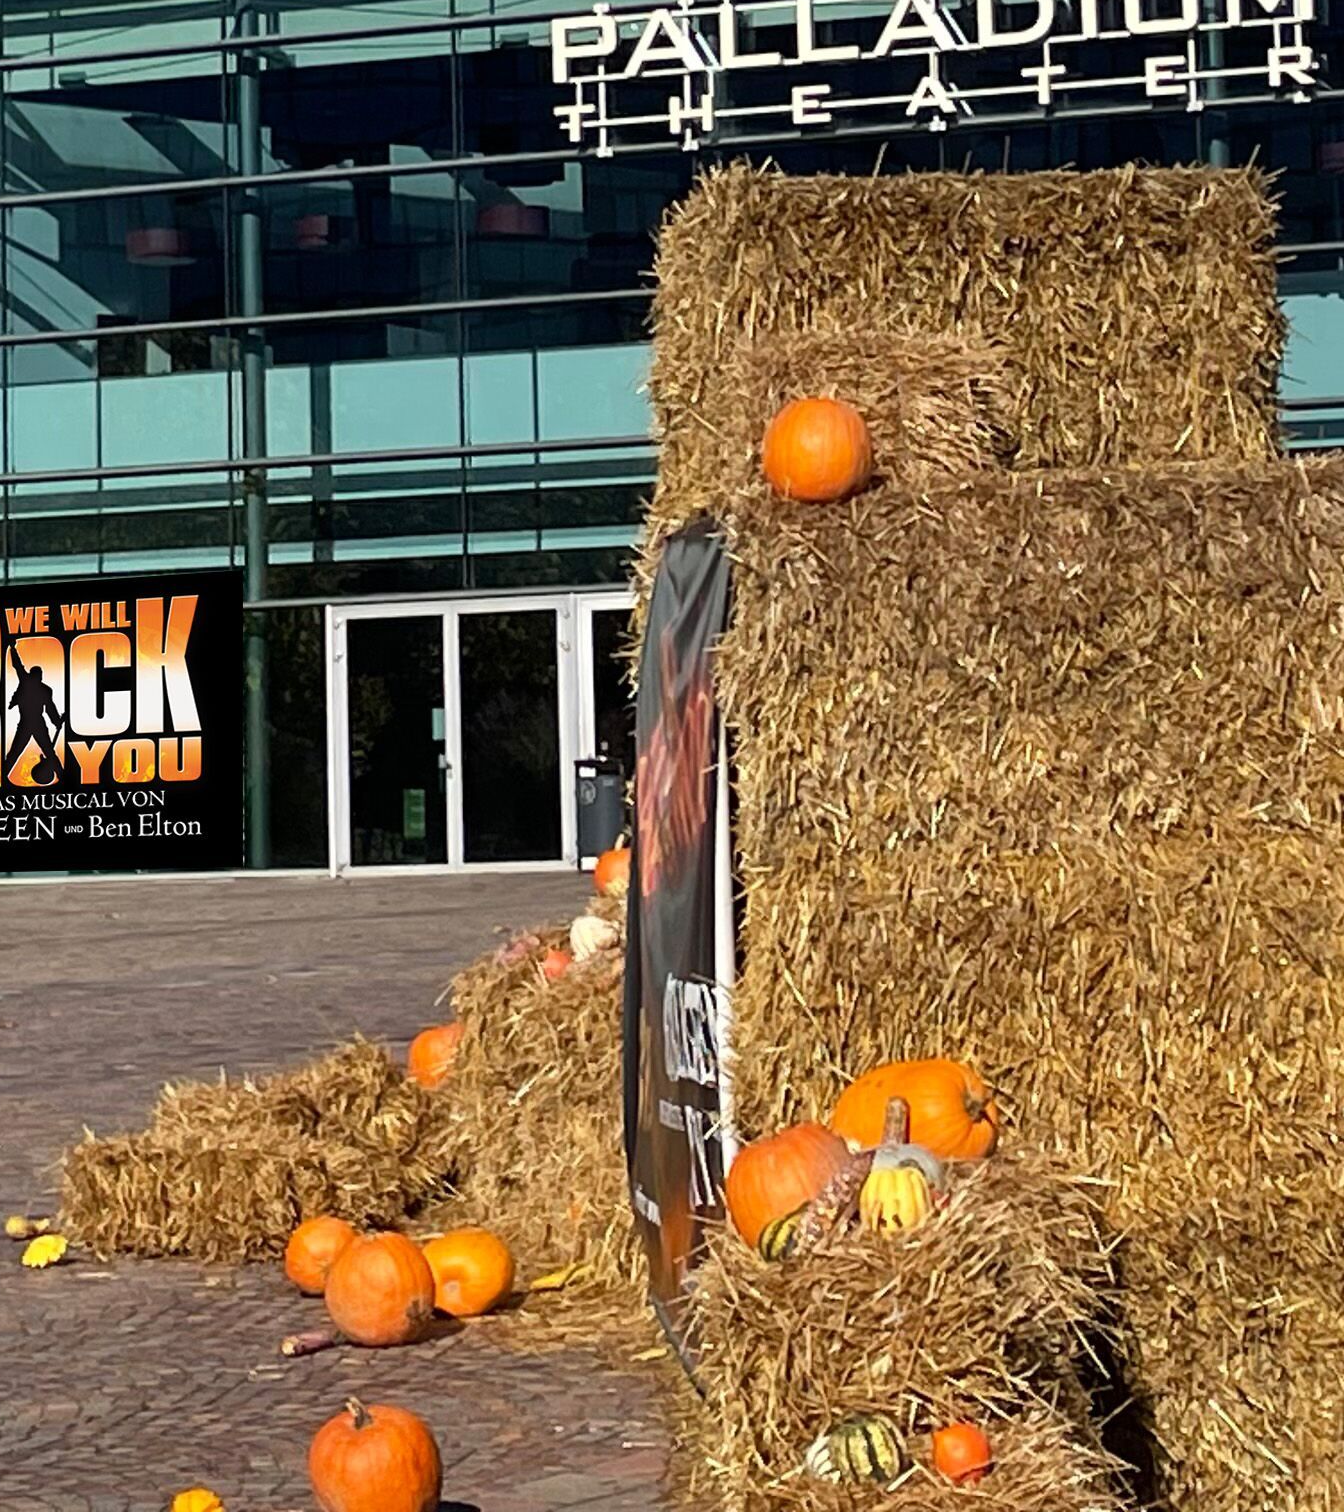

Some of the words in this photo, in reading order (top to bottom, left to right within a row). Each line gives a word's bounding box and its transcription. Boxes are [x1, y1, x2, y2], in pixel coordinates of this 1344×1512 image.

[553, 47, 1317, 142] THEATER
[5, 605, 50, 635] WE
[60, 600, 131, 631] WILL
[67, 736, 202, 784] YOU
[21, 792, 113, 810] MUSICAL
[117, 790, 166, 807] VON
[64, 825, 84, 834] UND
[88, 815, 132, 838] Ben
[138, 812, 202, 837] Elton
